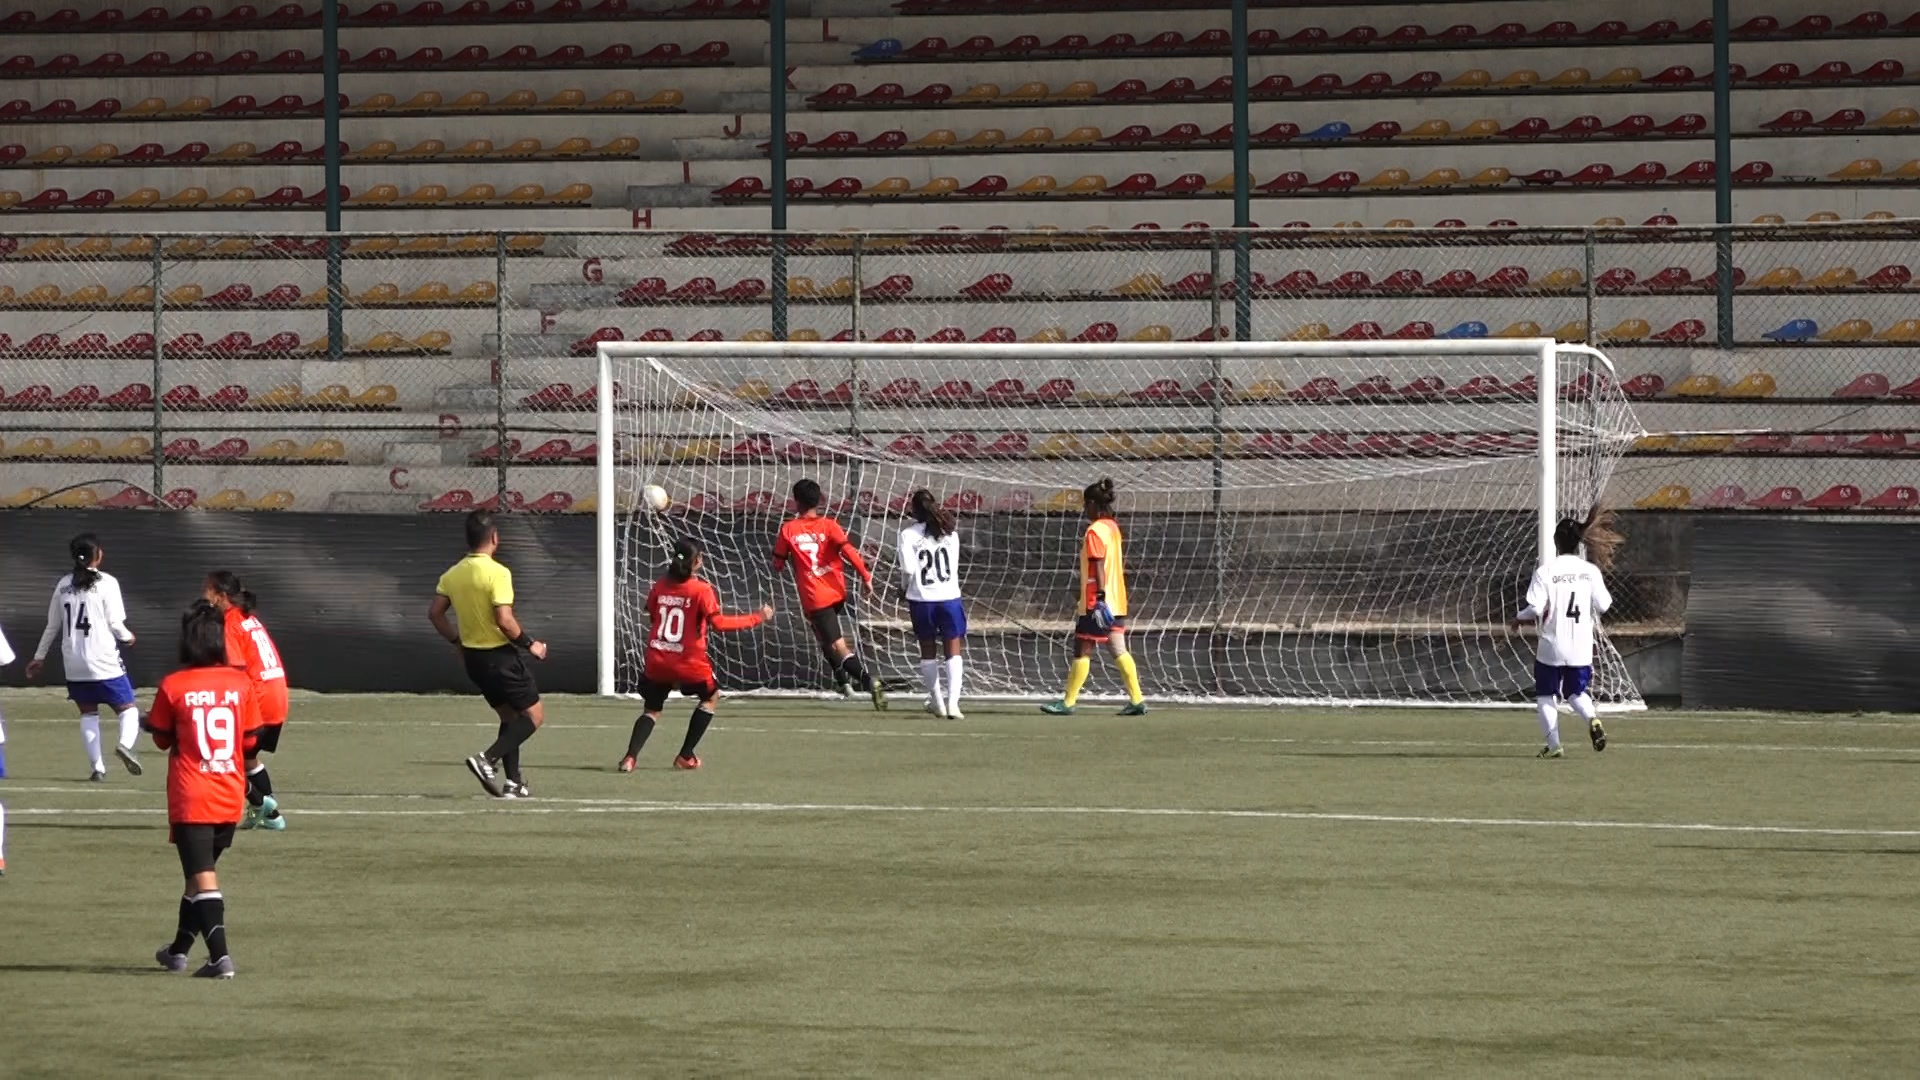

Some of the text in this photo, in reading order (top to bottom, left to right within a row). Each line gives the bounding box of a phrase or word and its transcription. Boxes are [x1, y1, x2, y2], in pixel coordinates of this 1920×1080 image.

[823, 19, 839, 42] L
[882, 41, 892, 49] 21
[723, 115, 742, 140] J
[1330, 123, 1341, 131] 43
[1185, 176, 1195, 184] 41
[96, 191, 105, 200] 21
[632, 209, 652, 229] H
[582, 257, 603, 283] G
[541, 311, 556, 334] F
[439, 414, 460, 439] D
[389, 467, 409, 490] C
[452, 493, 463, 502] 37
[799, 543, 819, 576] 7
[919, 546, 951, 586] 20
[1566, 591, 1581, 624] 4
[64, 602, 92, 638] 14
[657, 605, 685, 642] 10
[185, 691, 216, 706] RAI
[192, 706, 235, 761] 19
